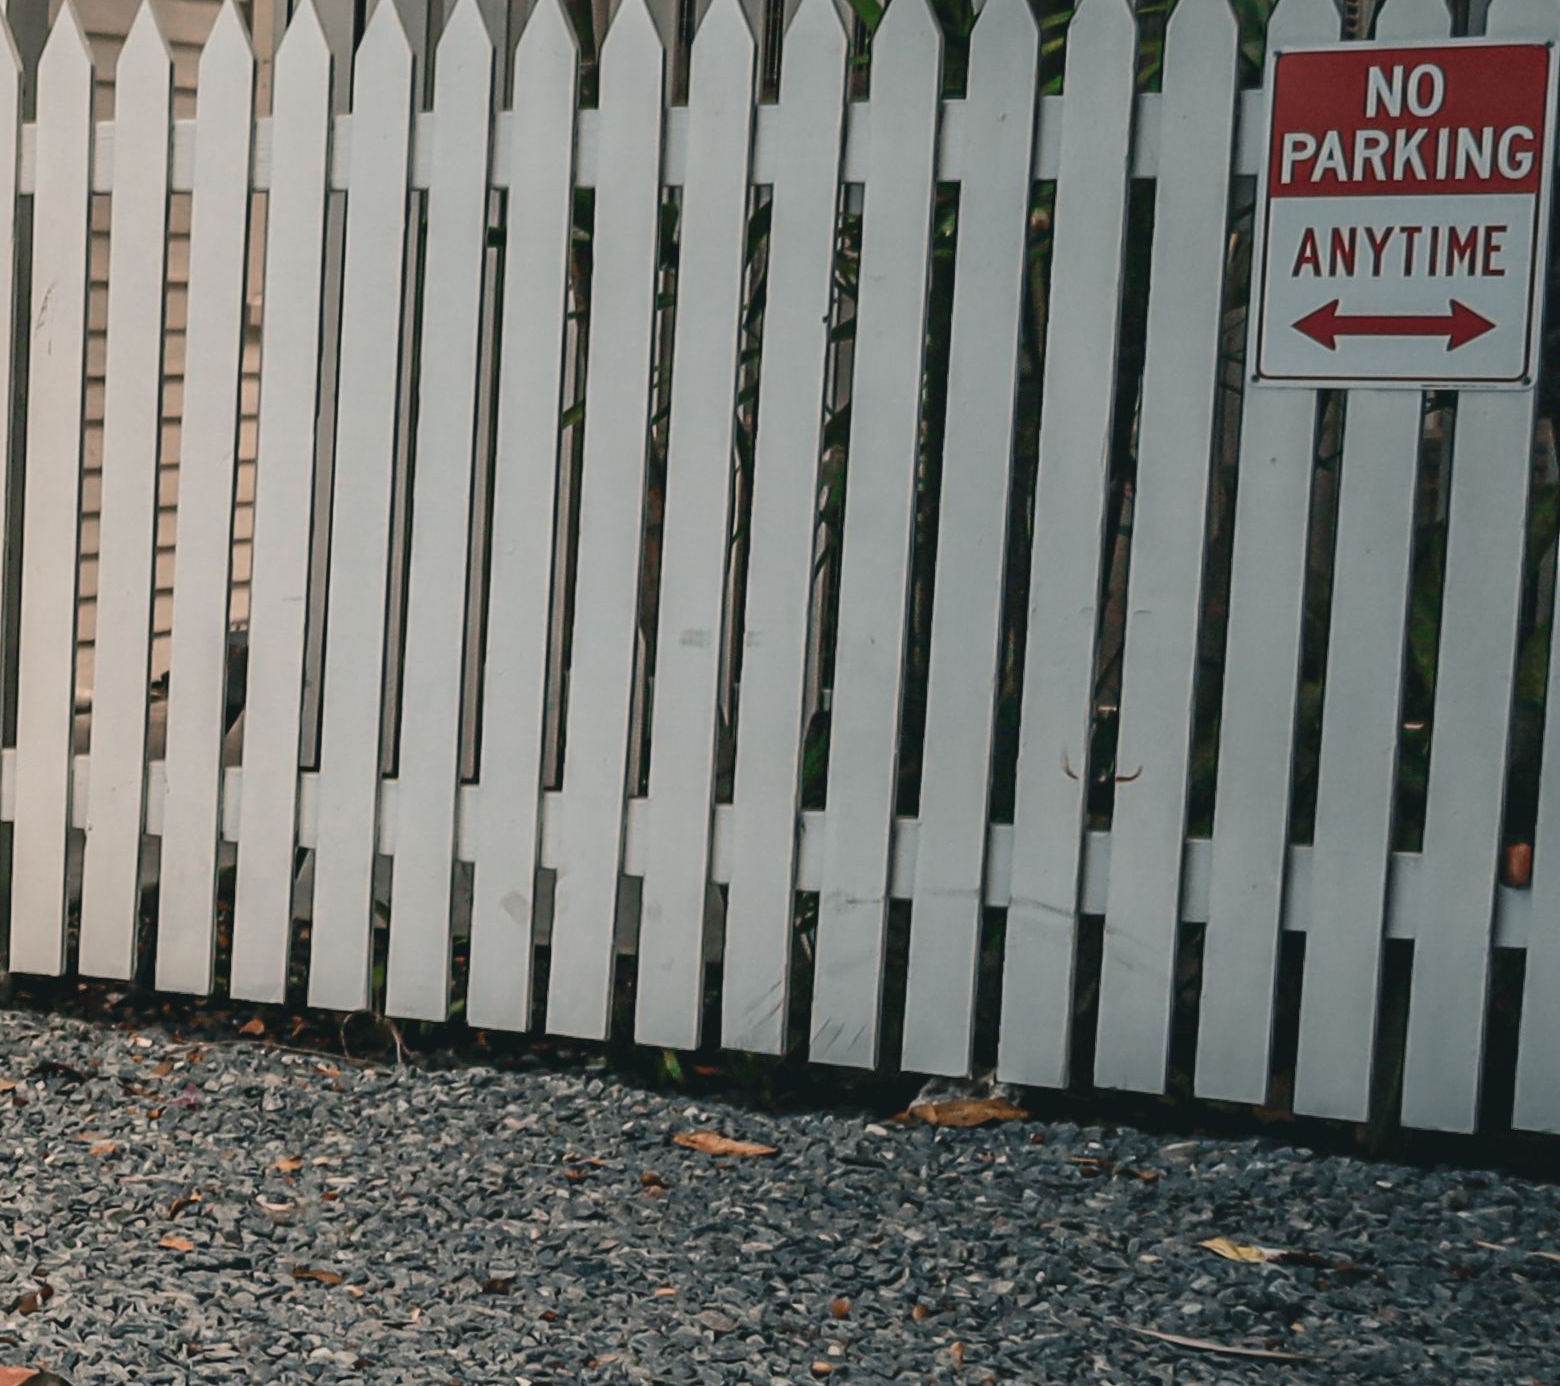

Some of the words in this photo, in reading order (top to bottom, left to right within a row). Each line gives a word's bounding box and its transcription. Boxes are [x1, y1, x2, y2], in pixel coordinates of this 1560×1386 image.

[1364, 62, 1446, 119] NO
[1279, 124, 1535, 185] PARKING
[1290, 224, 1508, 278] ANYTIME
